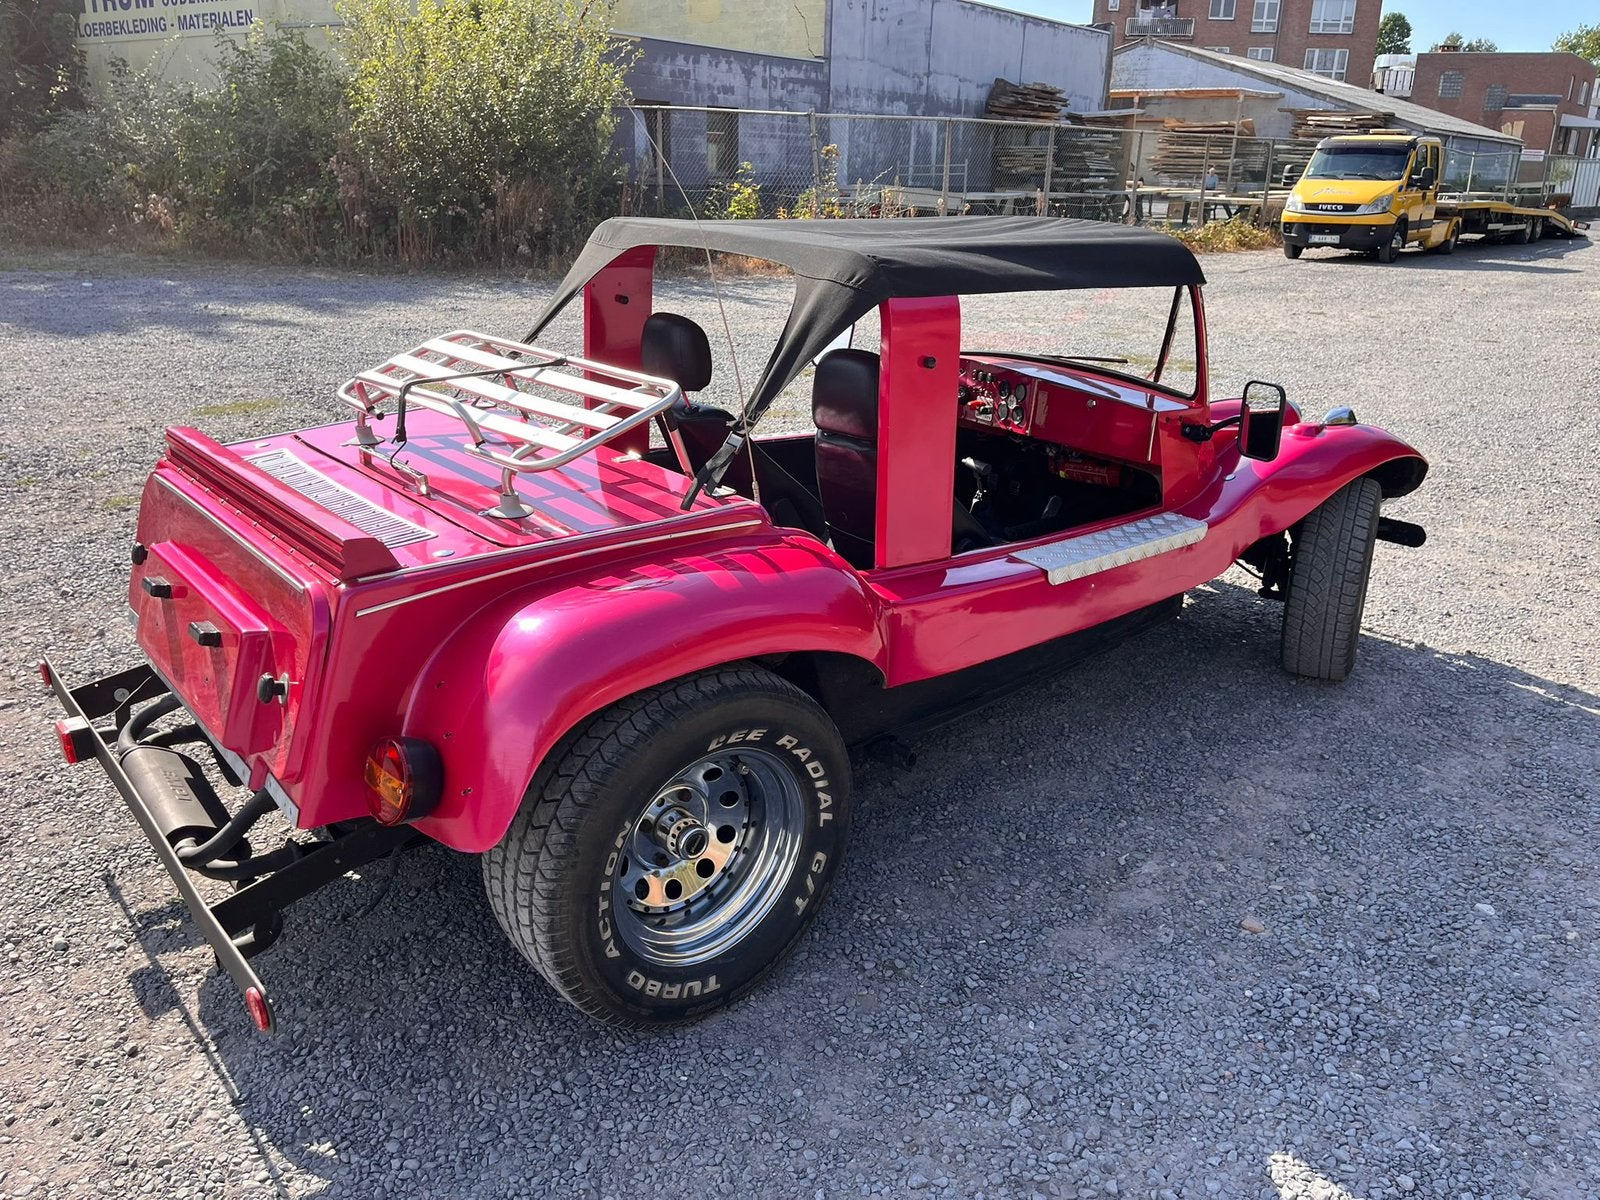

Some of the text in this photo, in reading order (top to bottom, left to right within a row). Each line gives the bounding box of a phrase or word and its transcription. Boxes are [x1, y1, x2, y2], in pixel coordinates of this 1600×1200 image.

[77, 16, 167, 38] LOERBEKLEDING
[178, 9, 253, 31] MATERIALEN
[598, 820, 721, 999] TURBO ACTION
[707, 729, 833, 916] LEE RADIAL G/T
